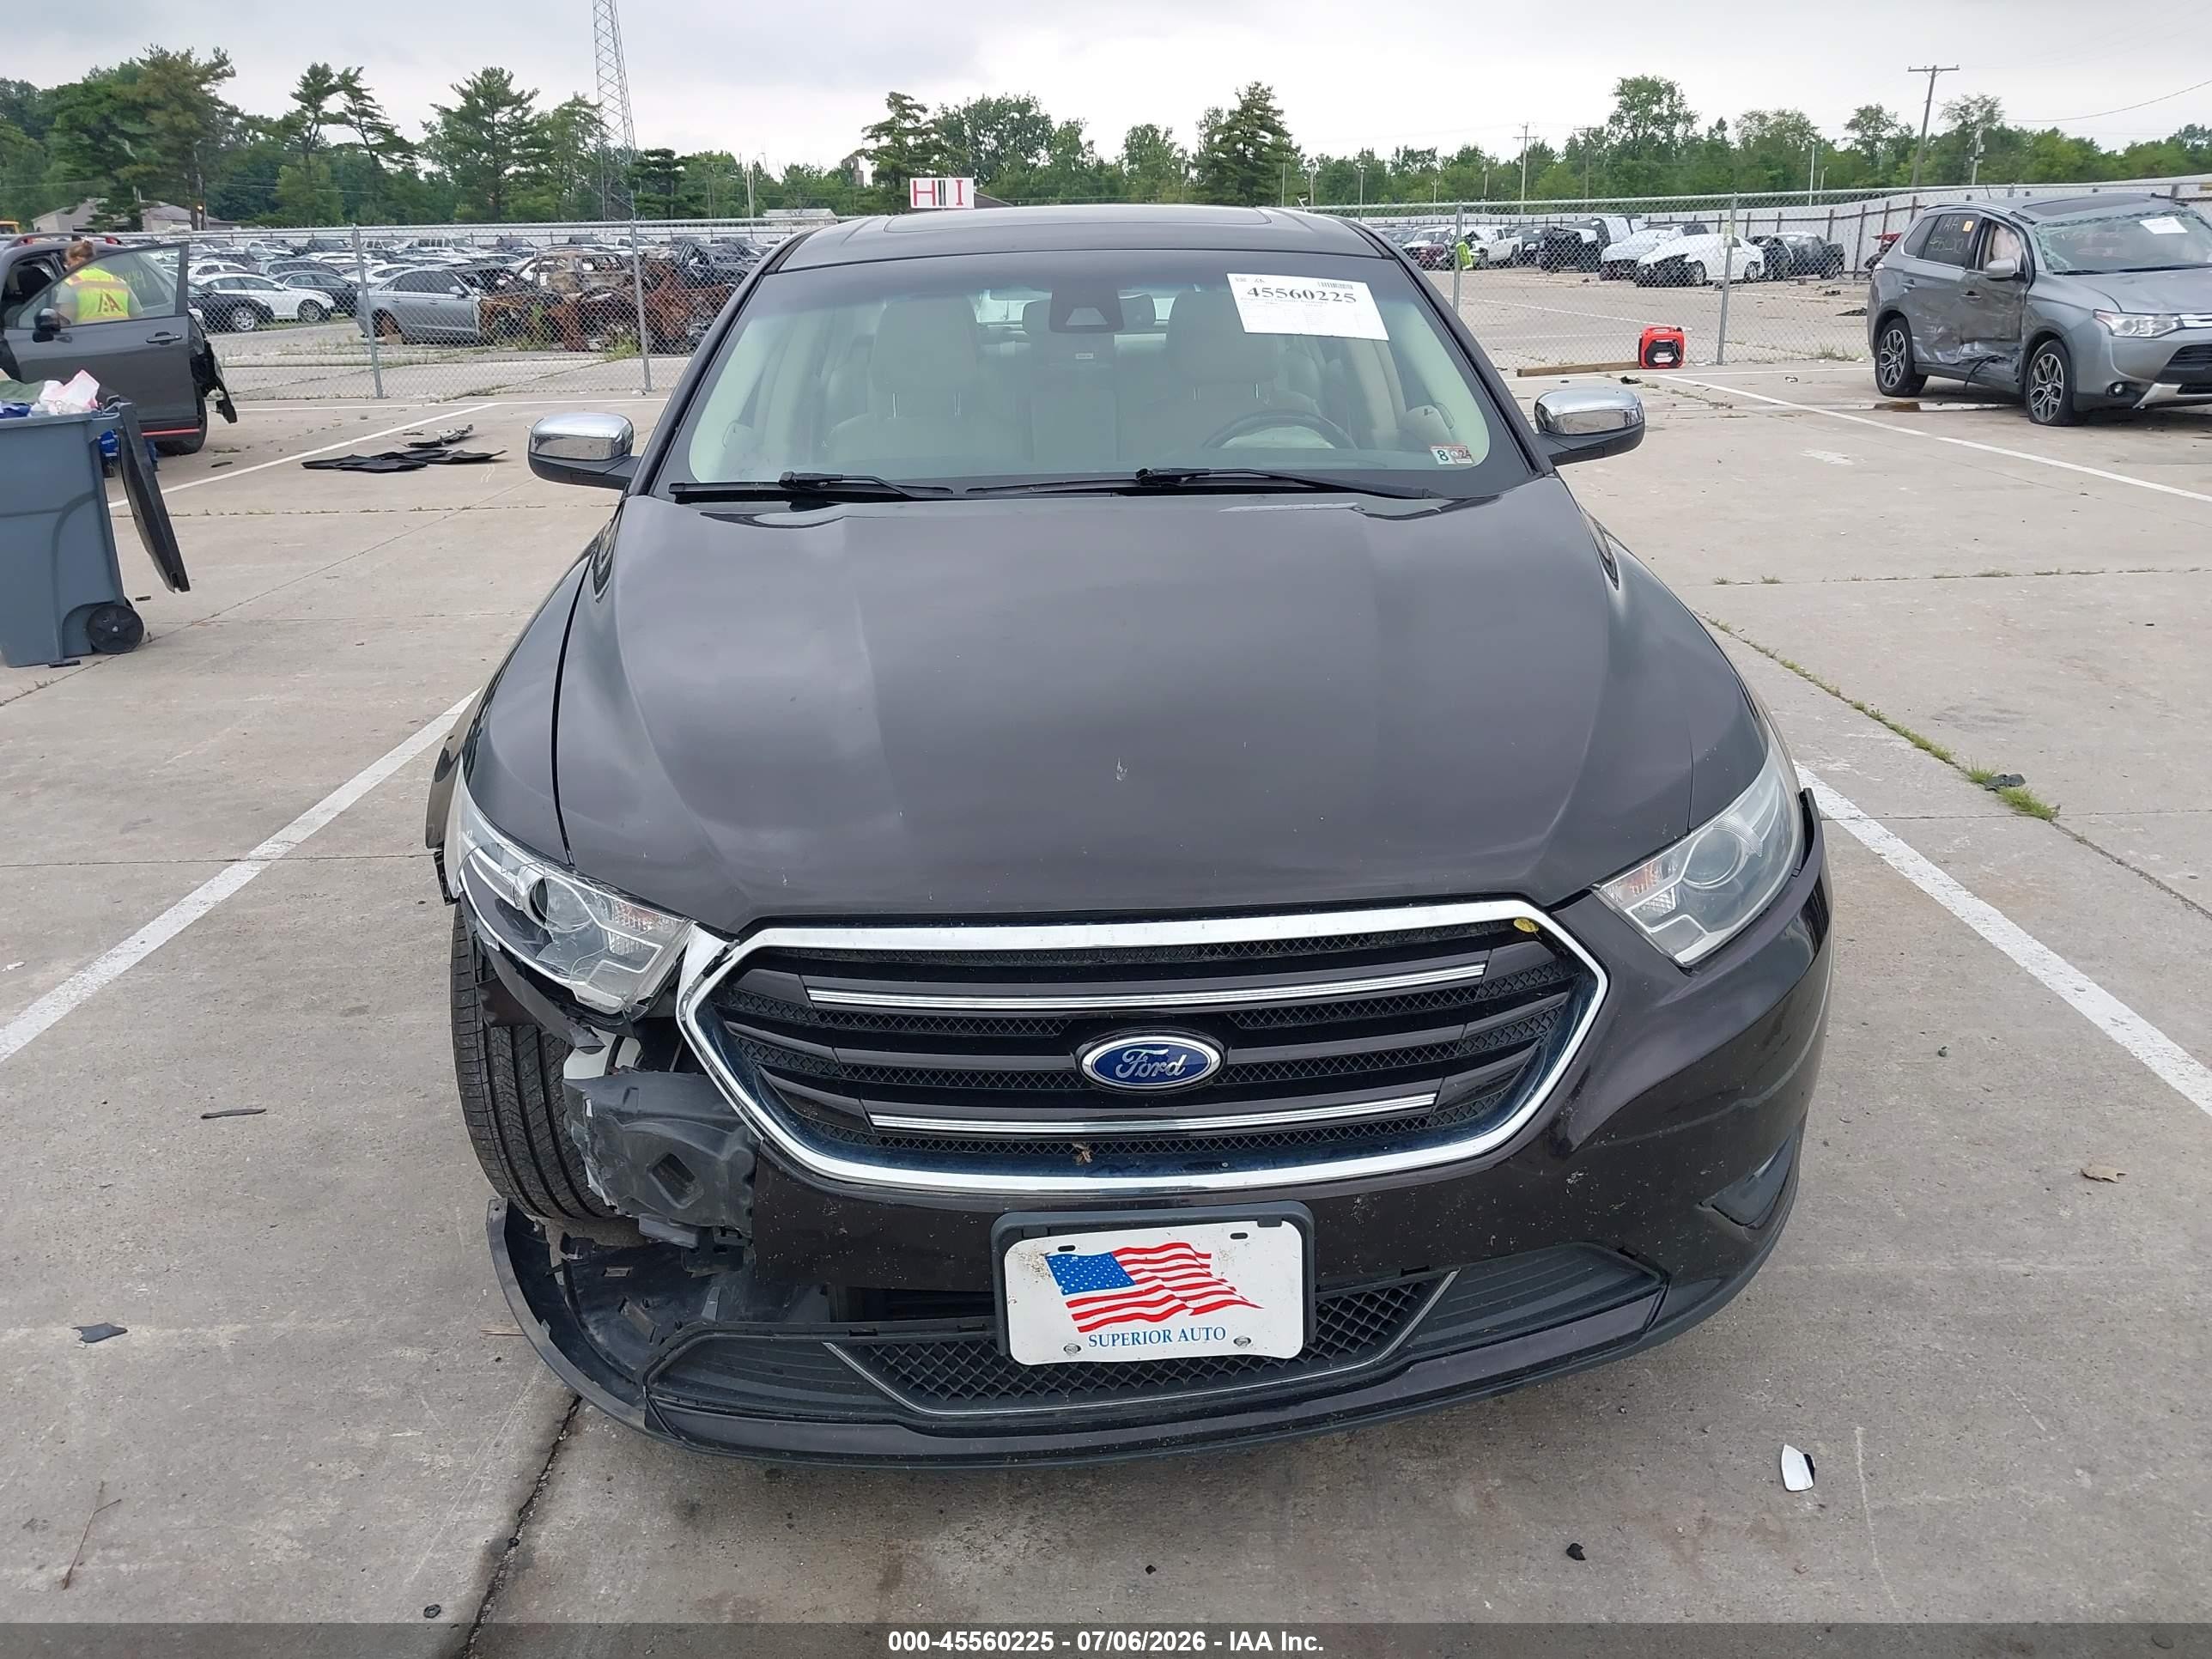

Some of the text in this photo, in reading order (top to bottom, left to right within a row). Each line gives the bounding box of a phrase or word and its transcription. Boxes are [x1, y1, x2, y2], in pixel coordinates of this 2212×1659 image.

[1247, 287, 1357, 303] 45560225
[1437, 449, 1449, 461] 8
[1115, 1048, 1188, 1079] Ford
[1088, 1327, 1226, 1348] SUPERIOR AUTO
